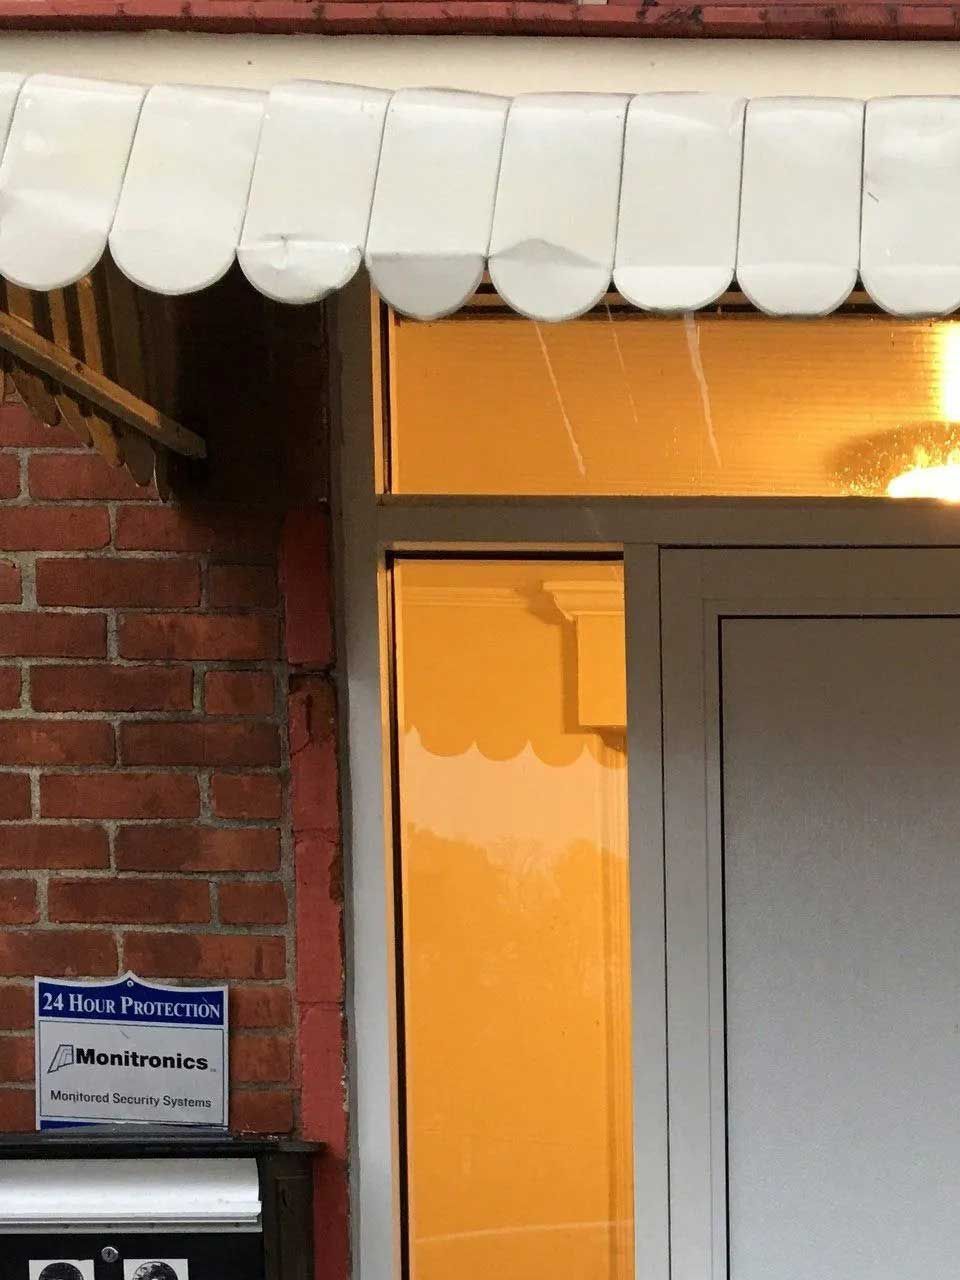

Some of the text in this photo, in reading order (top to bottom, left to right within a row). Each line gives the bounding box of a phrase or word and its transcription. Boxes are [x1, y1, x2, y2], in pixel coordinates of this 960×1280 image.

[42, 992, 221, 1019] 24 HOUR PROTECTION
[76, 1048, 209, 1071] Monitronics
[50, 1090, 212, 1109] Monitored Security Systems
